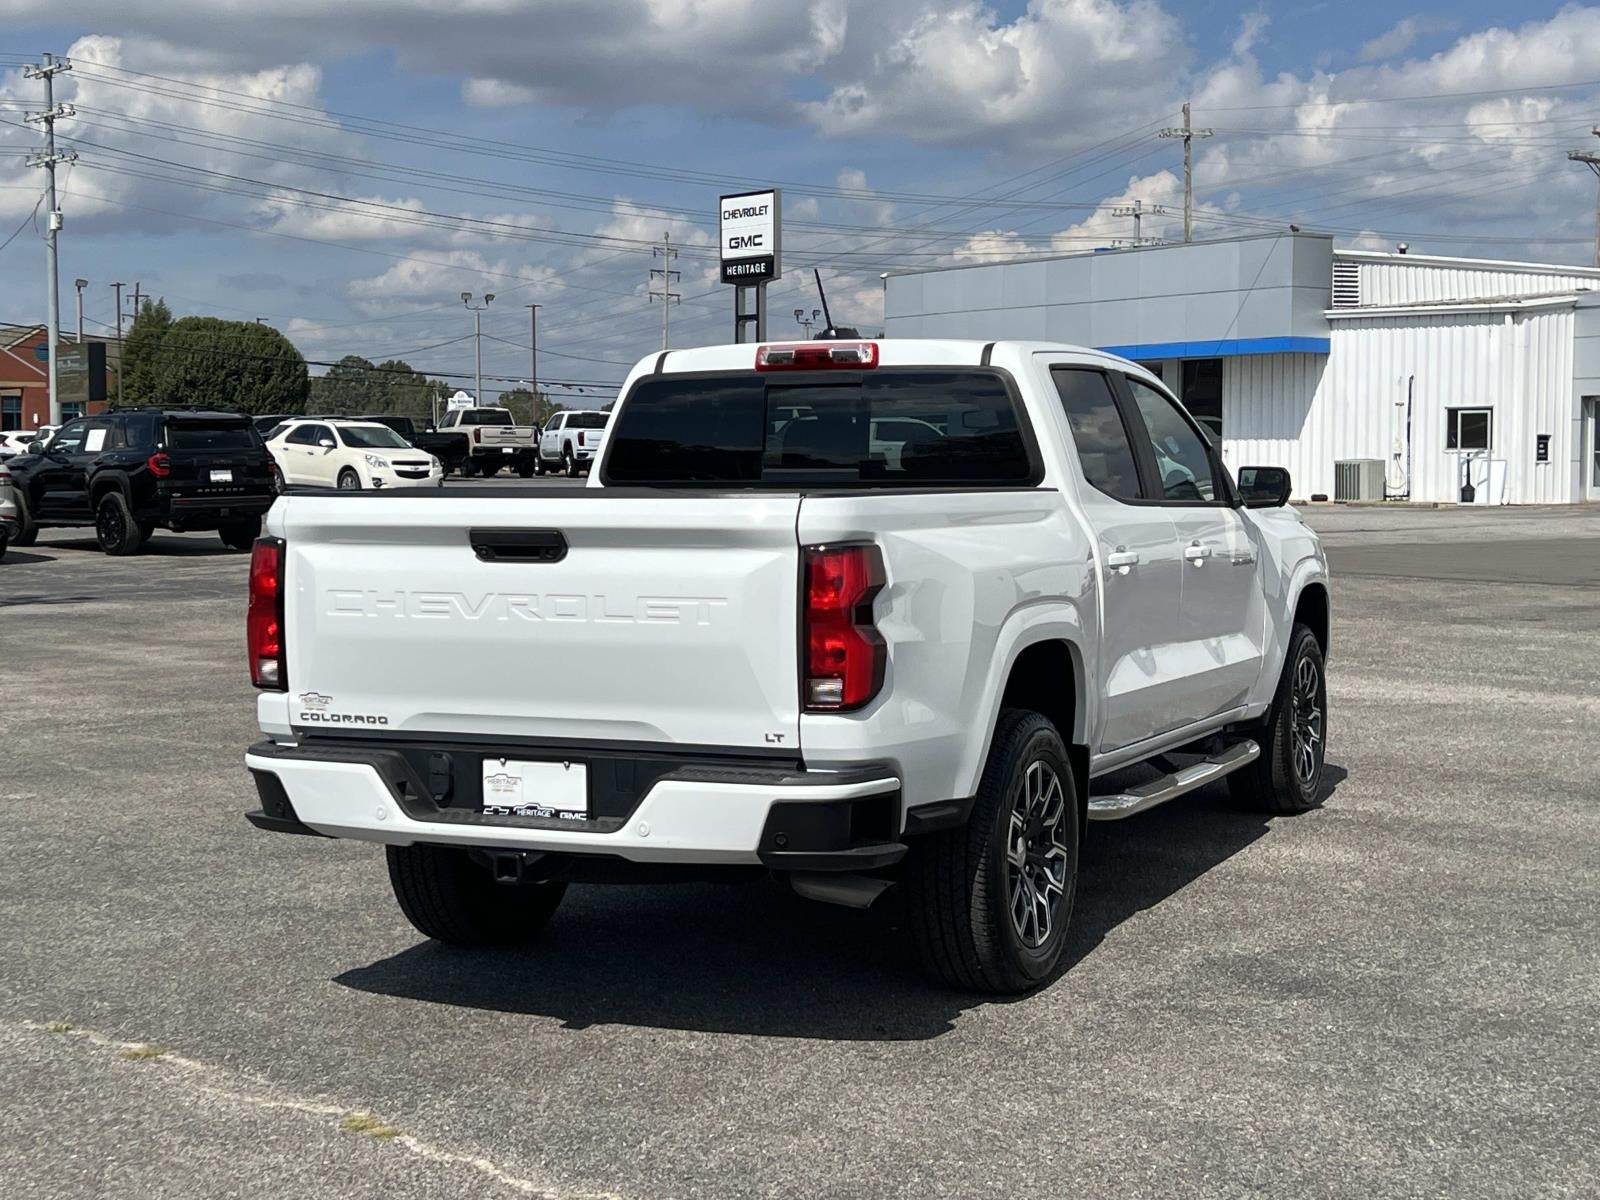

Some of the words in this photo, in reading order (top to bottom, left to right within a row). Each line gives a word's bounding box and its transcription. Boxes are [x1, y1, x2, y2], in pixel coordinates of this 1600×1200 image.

[723, 205, 769, 220] CHEVROLET
[729, 234, 763, 249] GMC
[726, 262, 766, 276] HERITAGE
[327, 590, 728, 625] CHEVROLET
[300, 713, 388, 724] COLORADO
[765, 733, 785, 743] LT
[517, 809, 551, 817] HERITAGE
[559, 812, 587, 821] GMC
